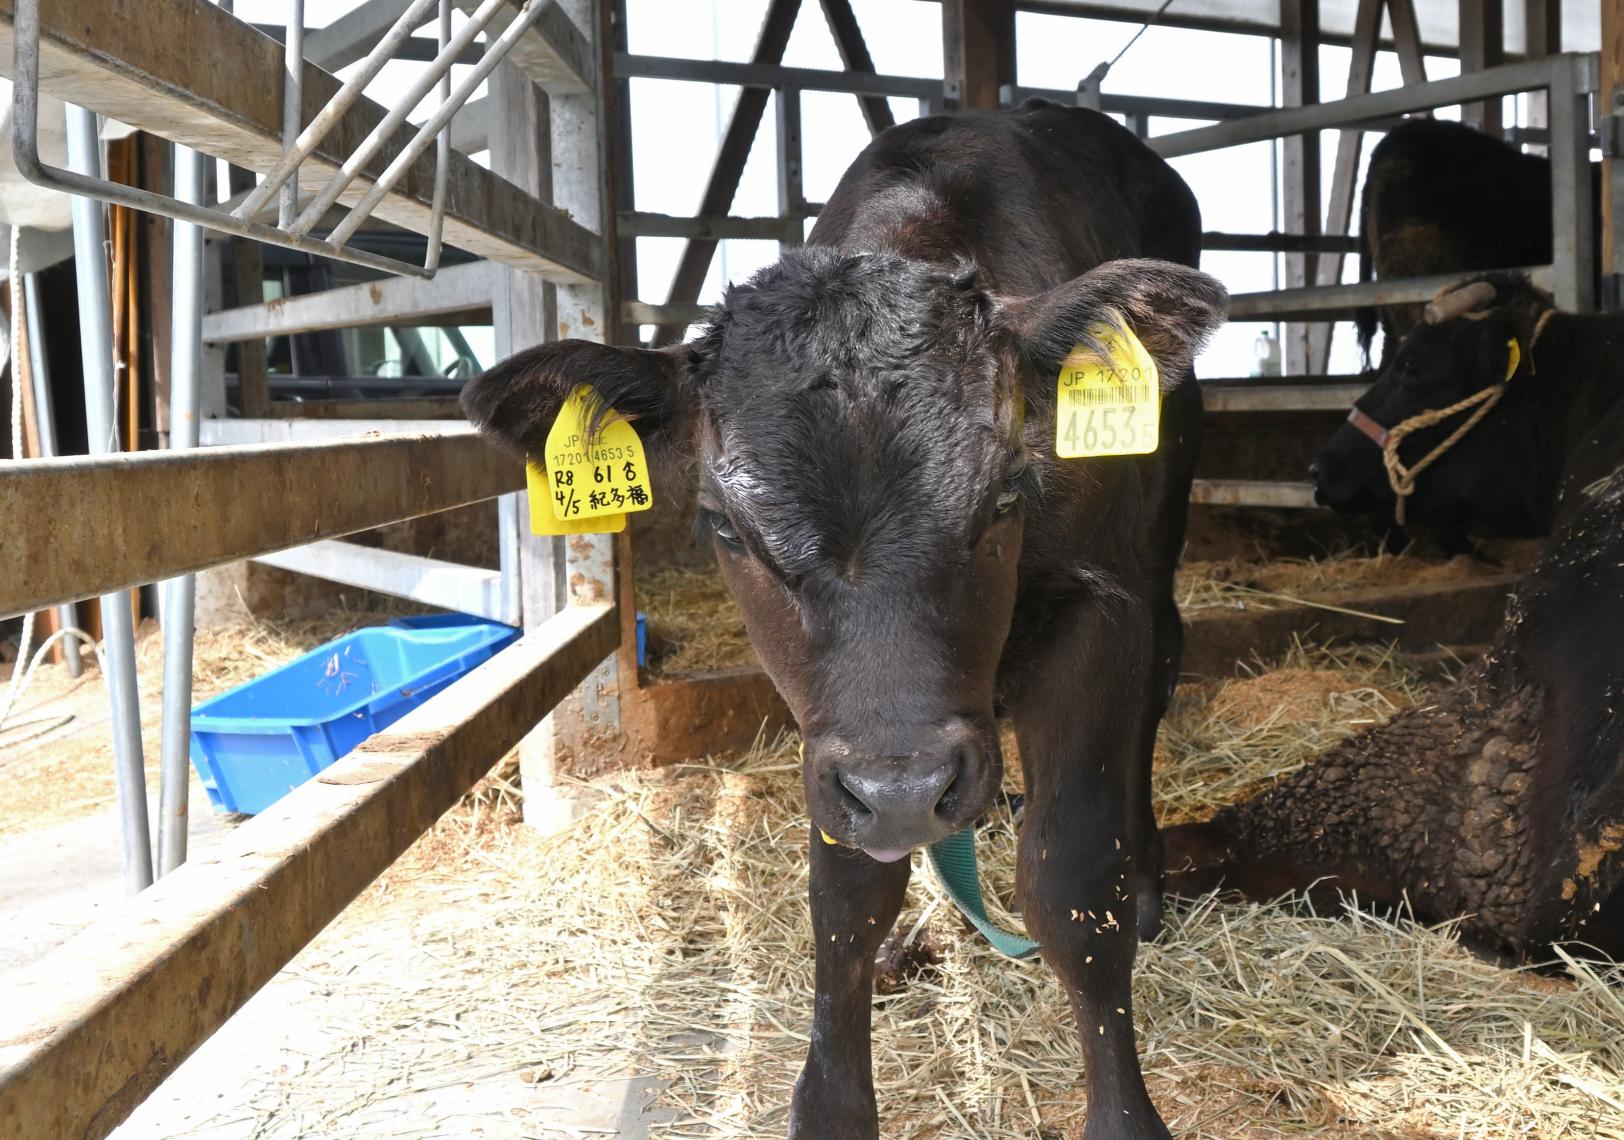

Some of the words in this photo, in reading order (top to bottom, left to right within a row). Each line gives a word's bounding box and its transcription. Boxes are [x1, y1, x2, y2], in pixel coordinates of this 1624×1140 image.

[1063, 371, 1085, 387] JP
[1064, 406, 1136, 451] 4653
[564, 434, 580, 449] JP
[594, 447, 623, 462] 4653
[626, 445, 634, 458] 5
[554, 470, 574, 488] R8
[593, 465, 612, 483] 61
[555, 488, 581, 517] 4/5
